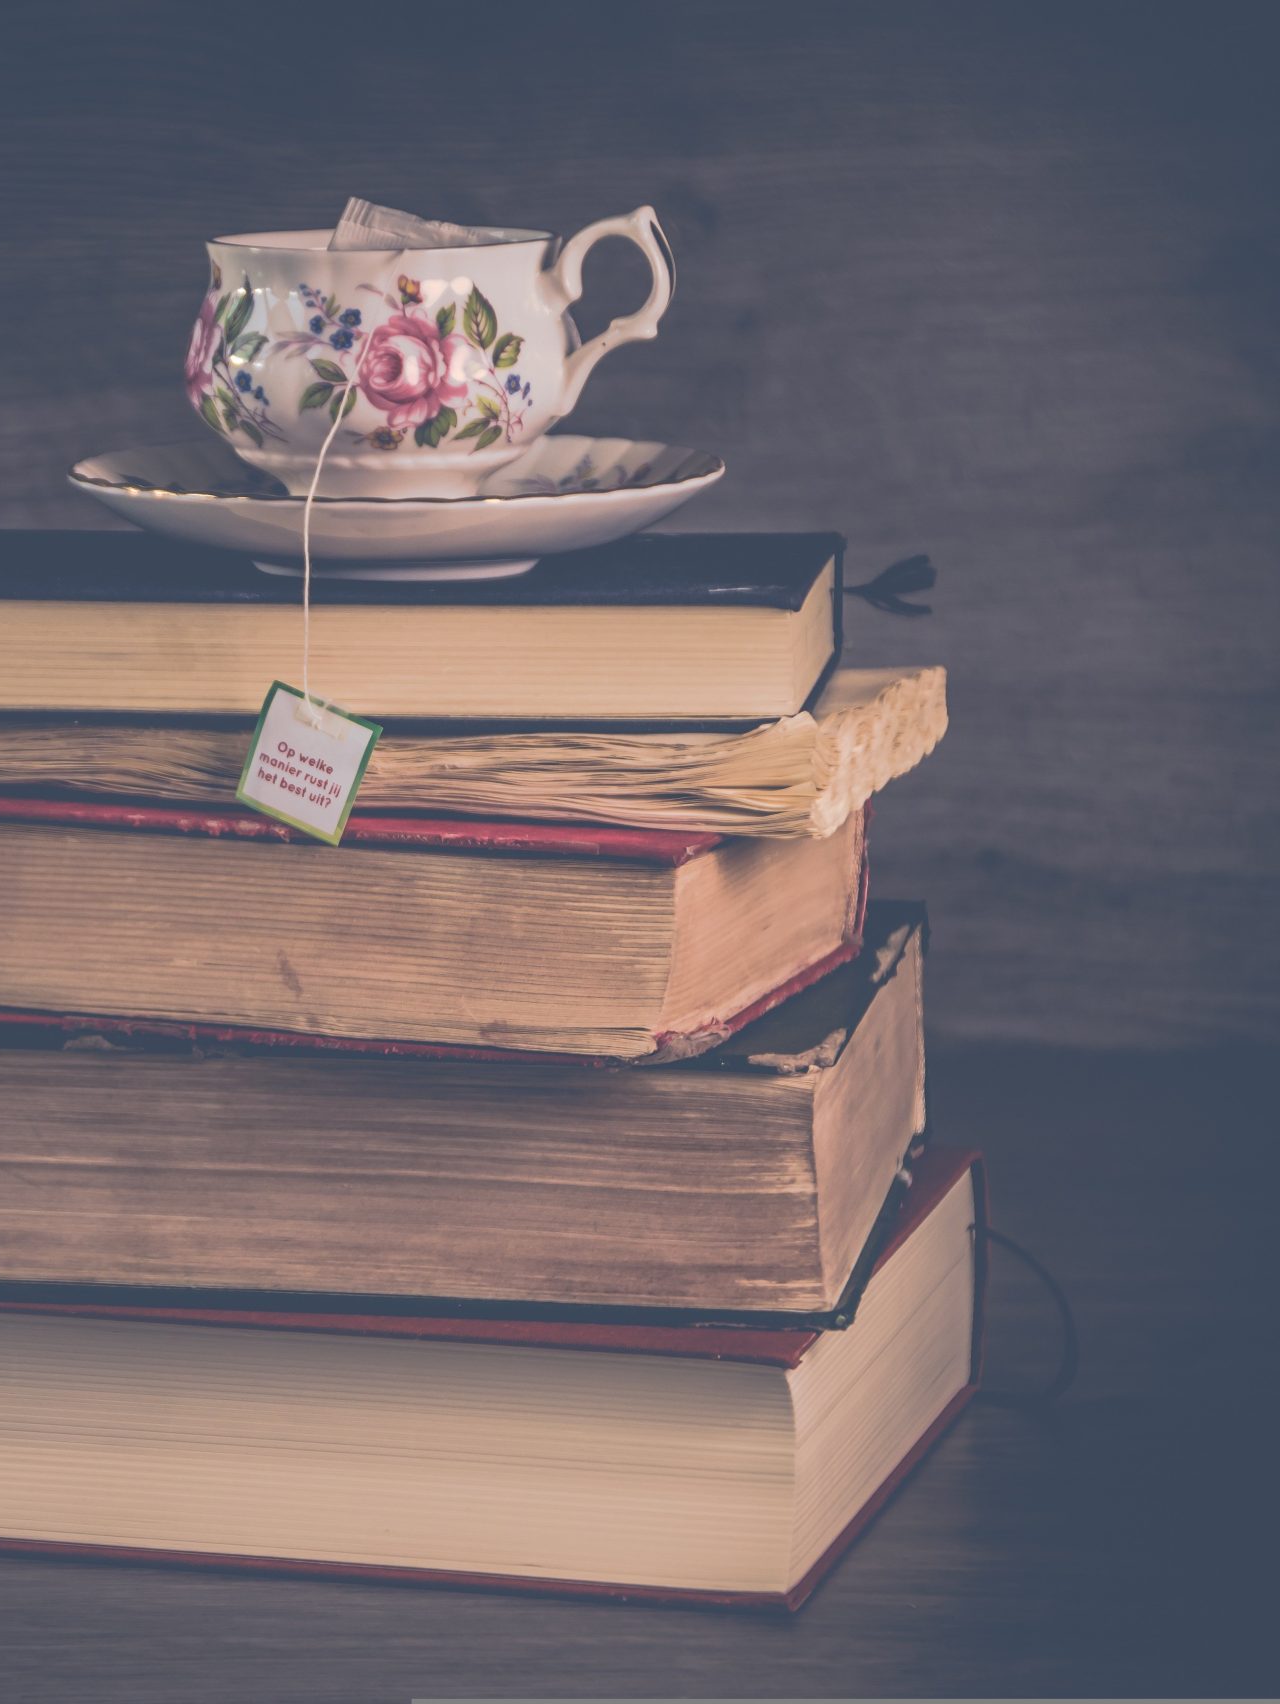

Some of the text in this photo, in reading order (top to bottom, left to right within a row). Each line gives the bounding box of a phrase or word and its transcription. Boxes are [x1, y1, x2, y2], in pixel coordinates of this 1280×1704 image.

[259, 752, 342, 798] manier rust jij
[277, 741, 334, 775] Op welke
[257, 766, 331, 808] het best uit?
